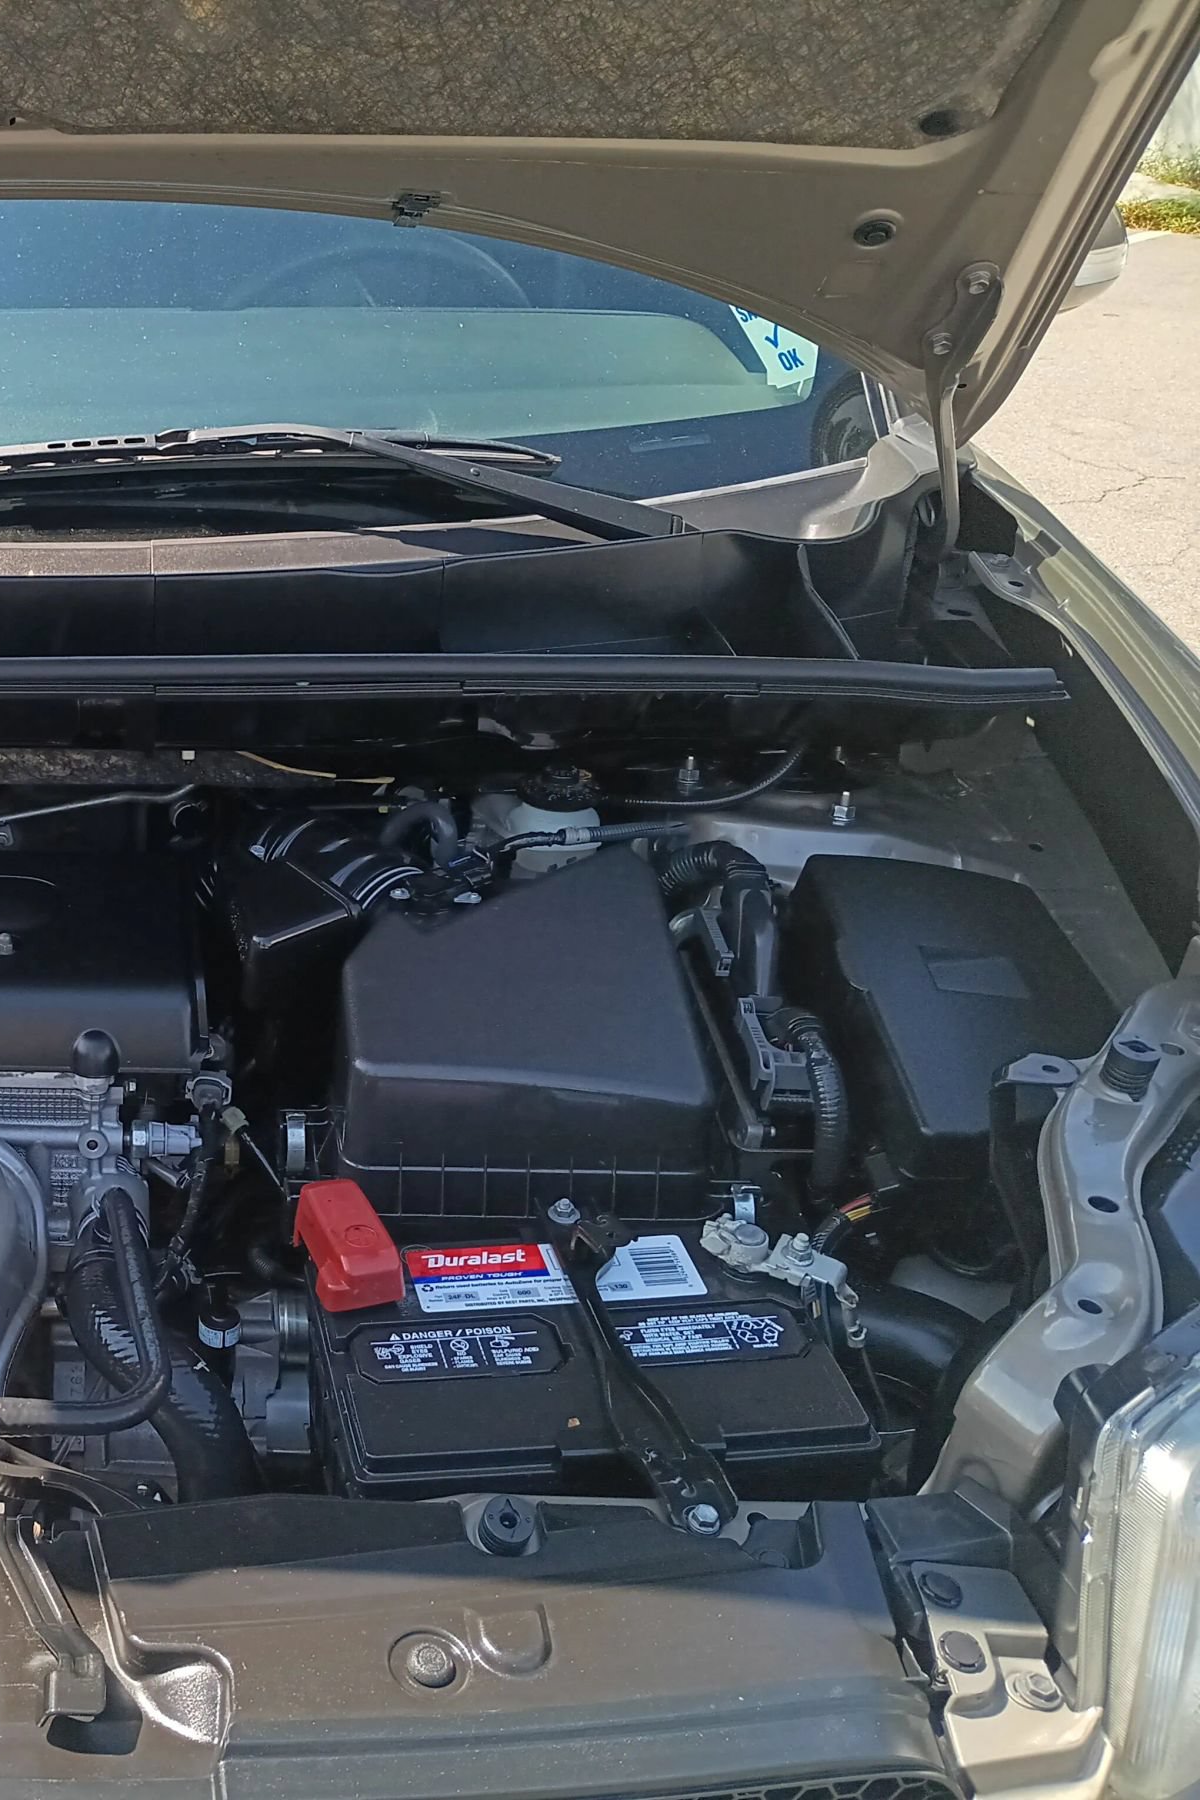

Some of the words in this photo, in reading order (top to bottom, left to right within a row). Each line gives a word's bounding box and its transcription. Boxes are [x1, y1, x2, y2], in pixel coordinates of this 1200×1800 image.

[777, 348, 804, 371] OK
[421, 1249, 526, 1268] Duralast
[402, 1329, 453, 1340] DANGER
[465, 1326, 512, 1336] POISON
